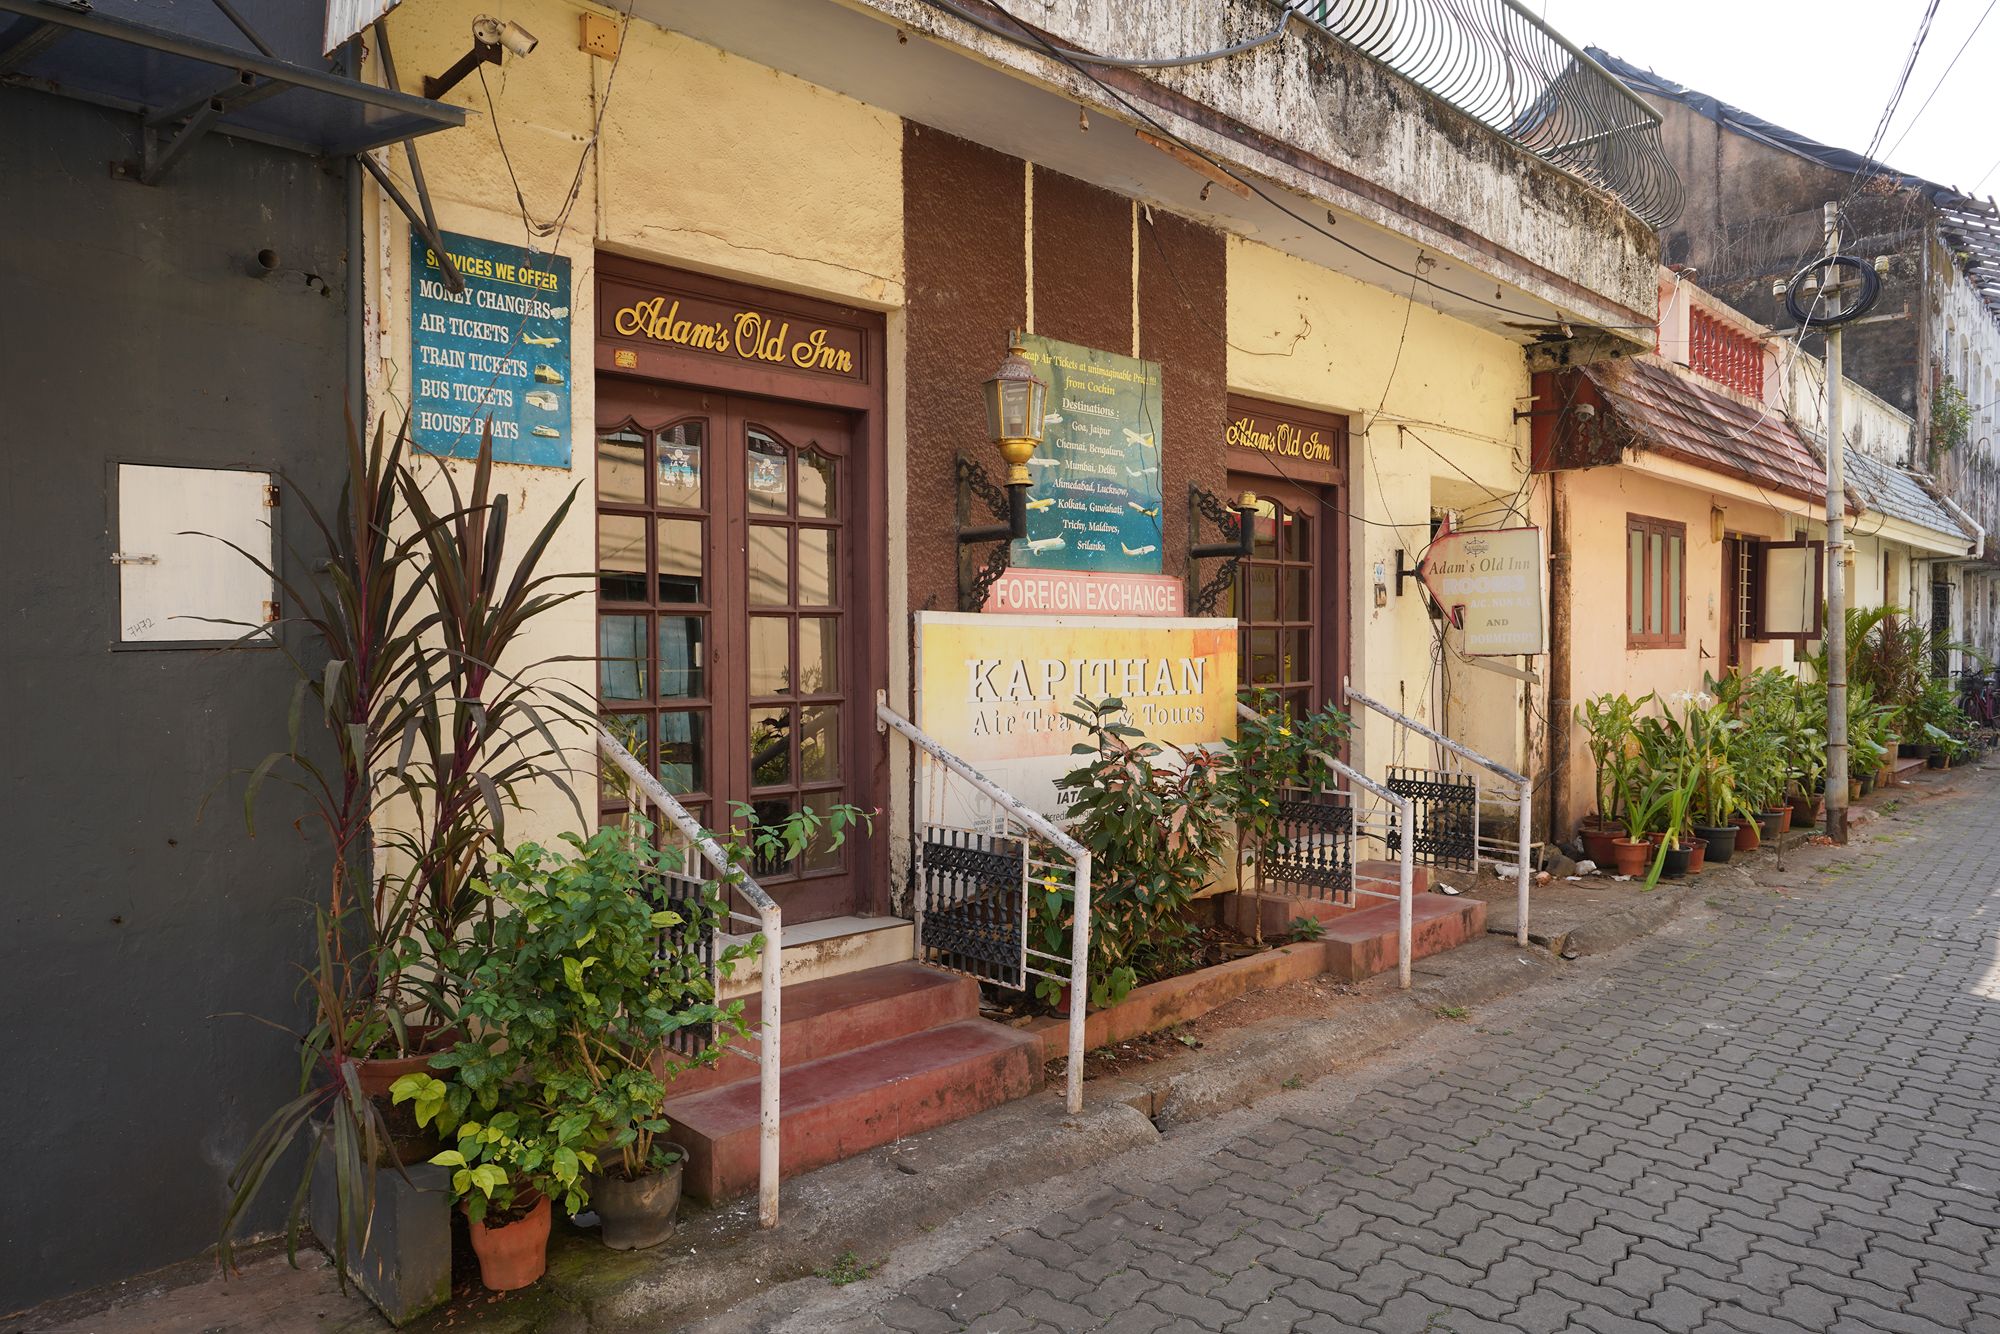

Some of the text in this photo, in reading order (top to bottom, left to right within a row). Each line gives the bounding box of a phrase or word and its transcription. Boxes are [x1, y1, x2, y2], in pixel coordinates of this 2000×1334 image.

[496, 262, 515, 281] WE
[519, 267, 558, 290] OFFER
[476, 290, 551, 320] CHANGERS
[420, 313, 510, 343] AIR TICKETS
[614, 297, 852, 373] Adam's Old Inn
[420, 346, 528, 378] TRAIN TICKETS
[1040, 353, 1052, 364] Air
[1054, 355, 1078, 370] Tickets
[1080, 363, 1086, 371] at
[1088, 364, 1132, 381] unimaginable
[420, 379, 513, 407] BUS TICKETS
[1064, 376, 1115, 395] from Cochin
[420, 412, 519, 439] HOUSE BATS
[1072, 421, 1111, 438] Goa, Jaipur
[1226, 418, 1331, 461] Adam's Old Inn
[1056, 438, 1125, 458] Chennai, Bengaluru,
[1065, 459, 1096, 472] Mumbai,
[1052, 477, 1129, 498] Ahmedabad, Lucknow,
[1058, 498, 1124, 516] Kolkata, Guwahati,
[1062, 519, 1120, 535] Trichy, Maldives,
[1429, 557, 1530, 575] Adam's Old Inn
[996, 578, 1176, 613] FOREIGN EXCHANGE
[1486, 619, 1509, 627] AND
[965, 658, 1207, 703] KAPITHAN
[973, 709, 1016, 736] Air
[1141, 703, 1206, 727] Tours
